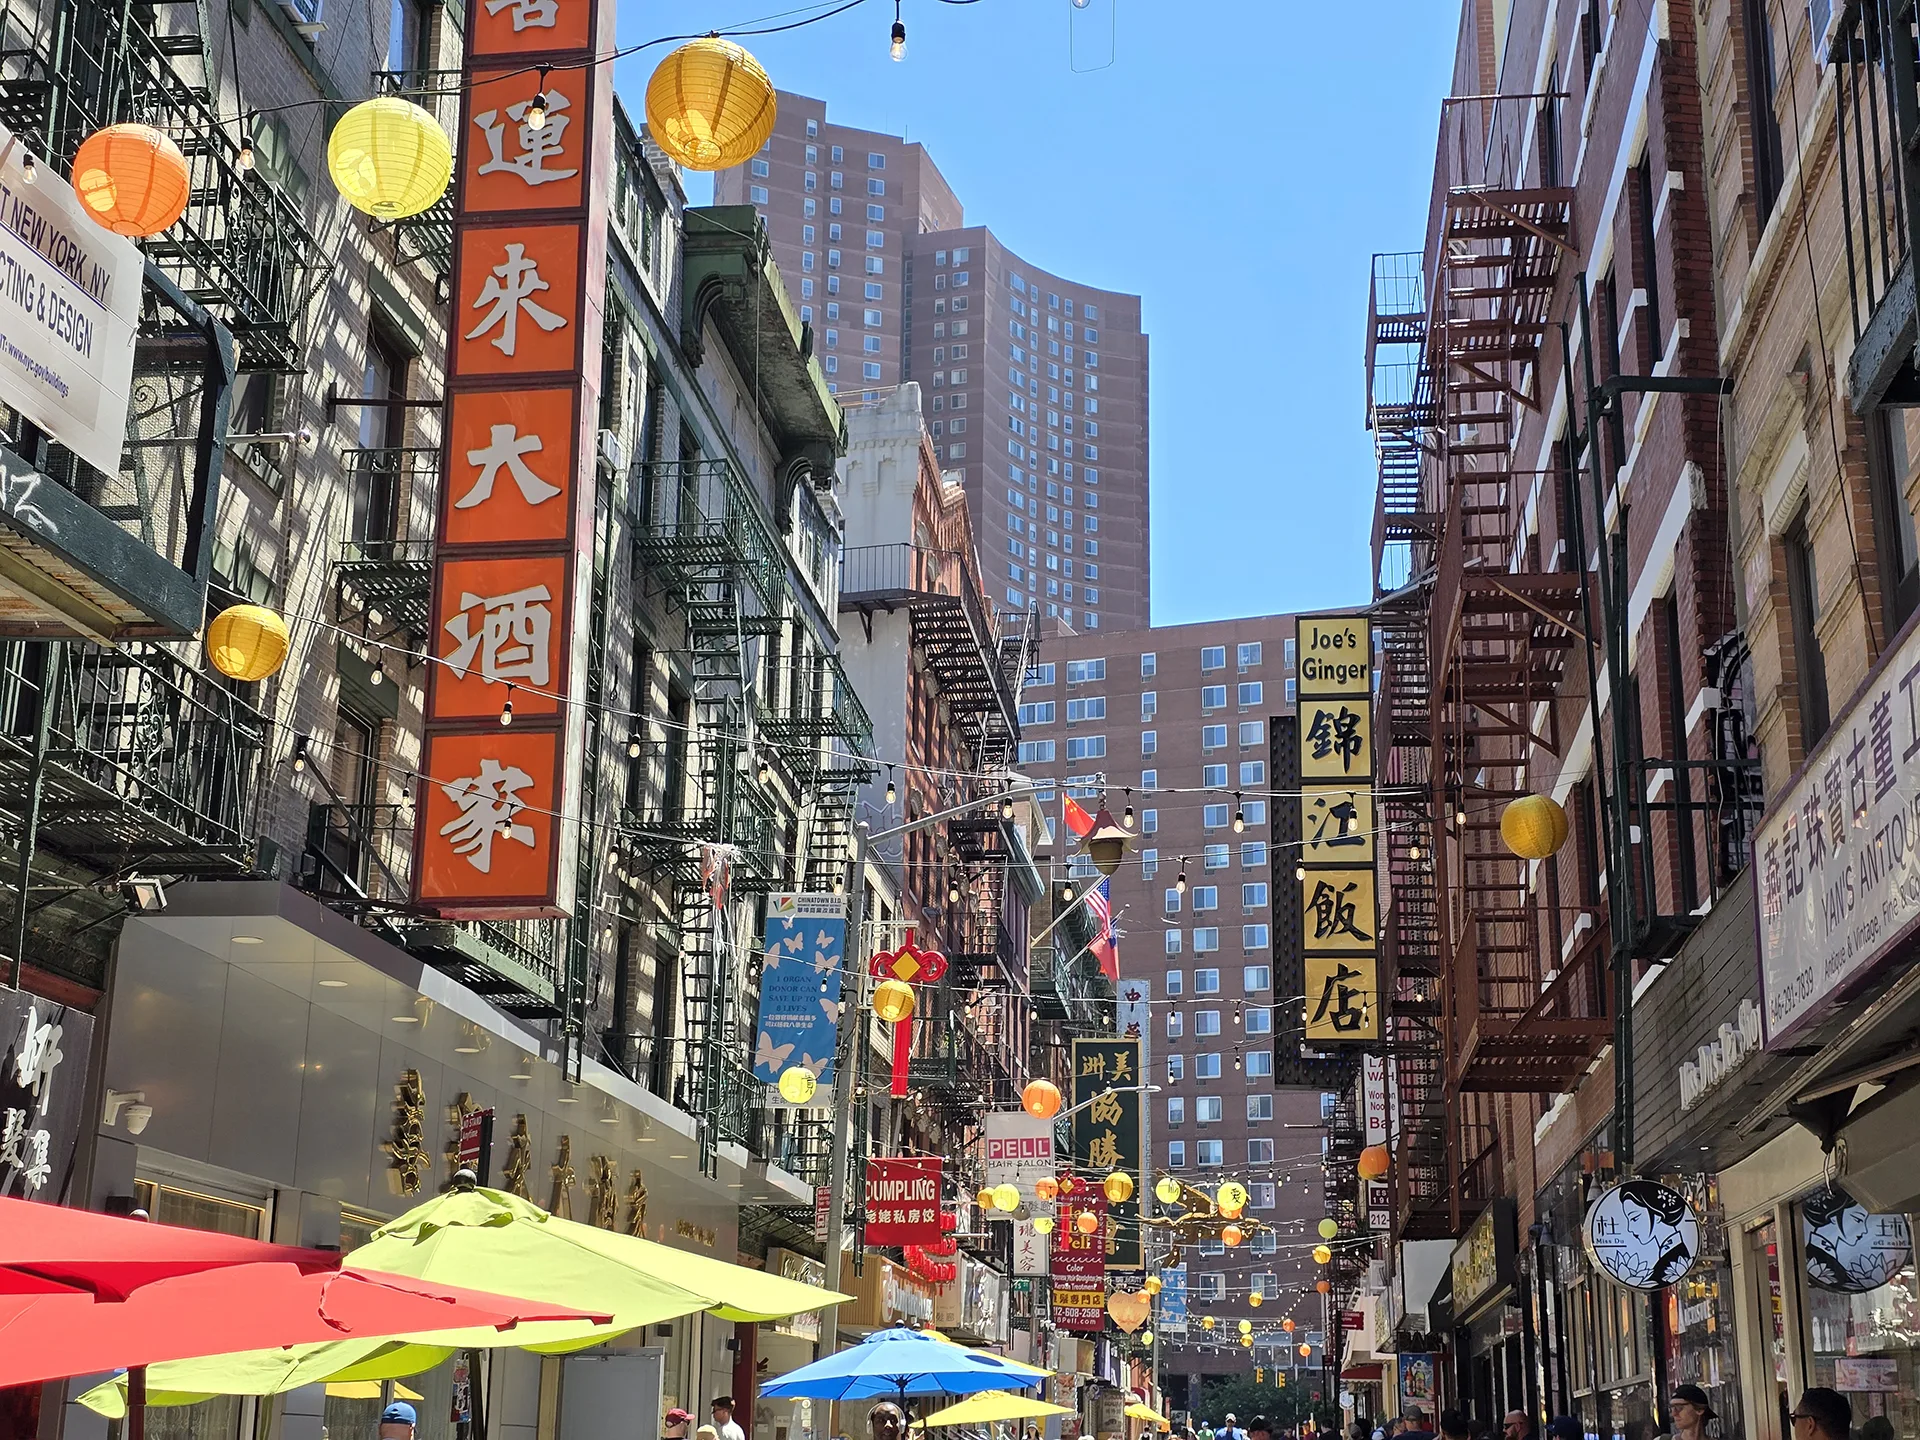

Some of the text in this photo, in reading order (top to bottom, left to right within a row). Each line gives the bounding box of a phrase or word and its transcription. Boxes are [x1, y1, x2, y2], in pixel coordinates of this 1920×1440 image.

[11, 197, 48, 248] NEW
[48, 223, 87, 290] YORK,
[91, 261, 111, 301] NY
[37, 282, 45, 323] &
[48, 292, 93, 359] DESIGN
[8, 341, 70, 399] www.nyc.gov/buildings
[1310, 627, 1357, 650] Joe's
[1301, 657, 1368, 684] Ginger
[1305, 706, 1373, 1032] 錦江飯店
[1821, 793, 1920, 937] YAN'S ANTIQU
[1882, 897, 1899, 927] Fine
[800, 985, 818, 993] CAN
[805, 995, 817, 1003] TO
[1368, 1090, 1396, 1100] Wonn
[1370, 1102, 1396, 1111] Nooe
[990, 1139, 1049, 1158] PELL
[989, 1159, 1052, 1168] HAIR SALON
[865, 1179, 935, 1201] DUMPLING
[1596, 1216, 1621, 1237] 杜
[1066, 1264, 1084, 1272] Color
